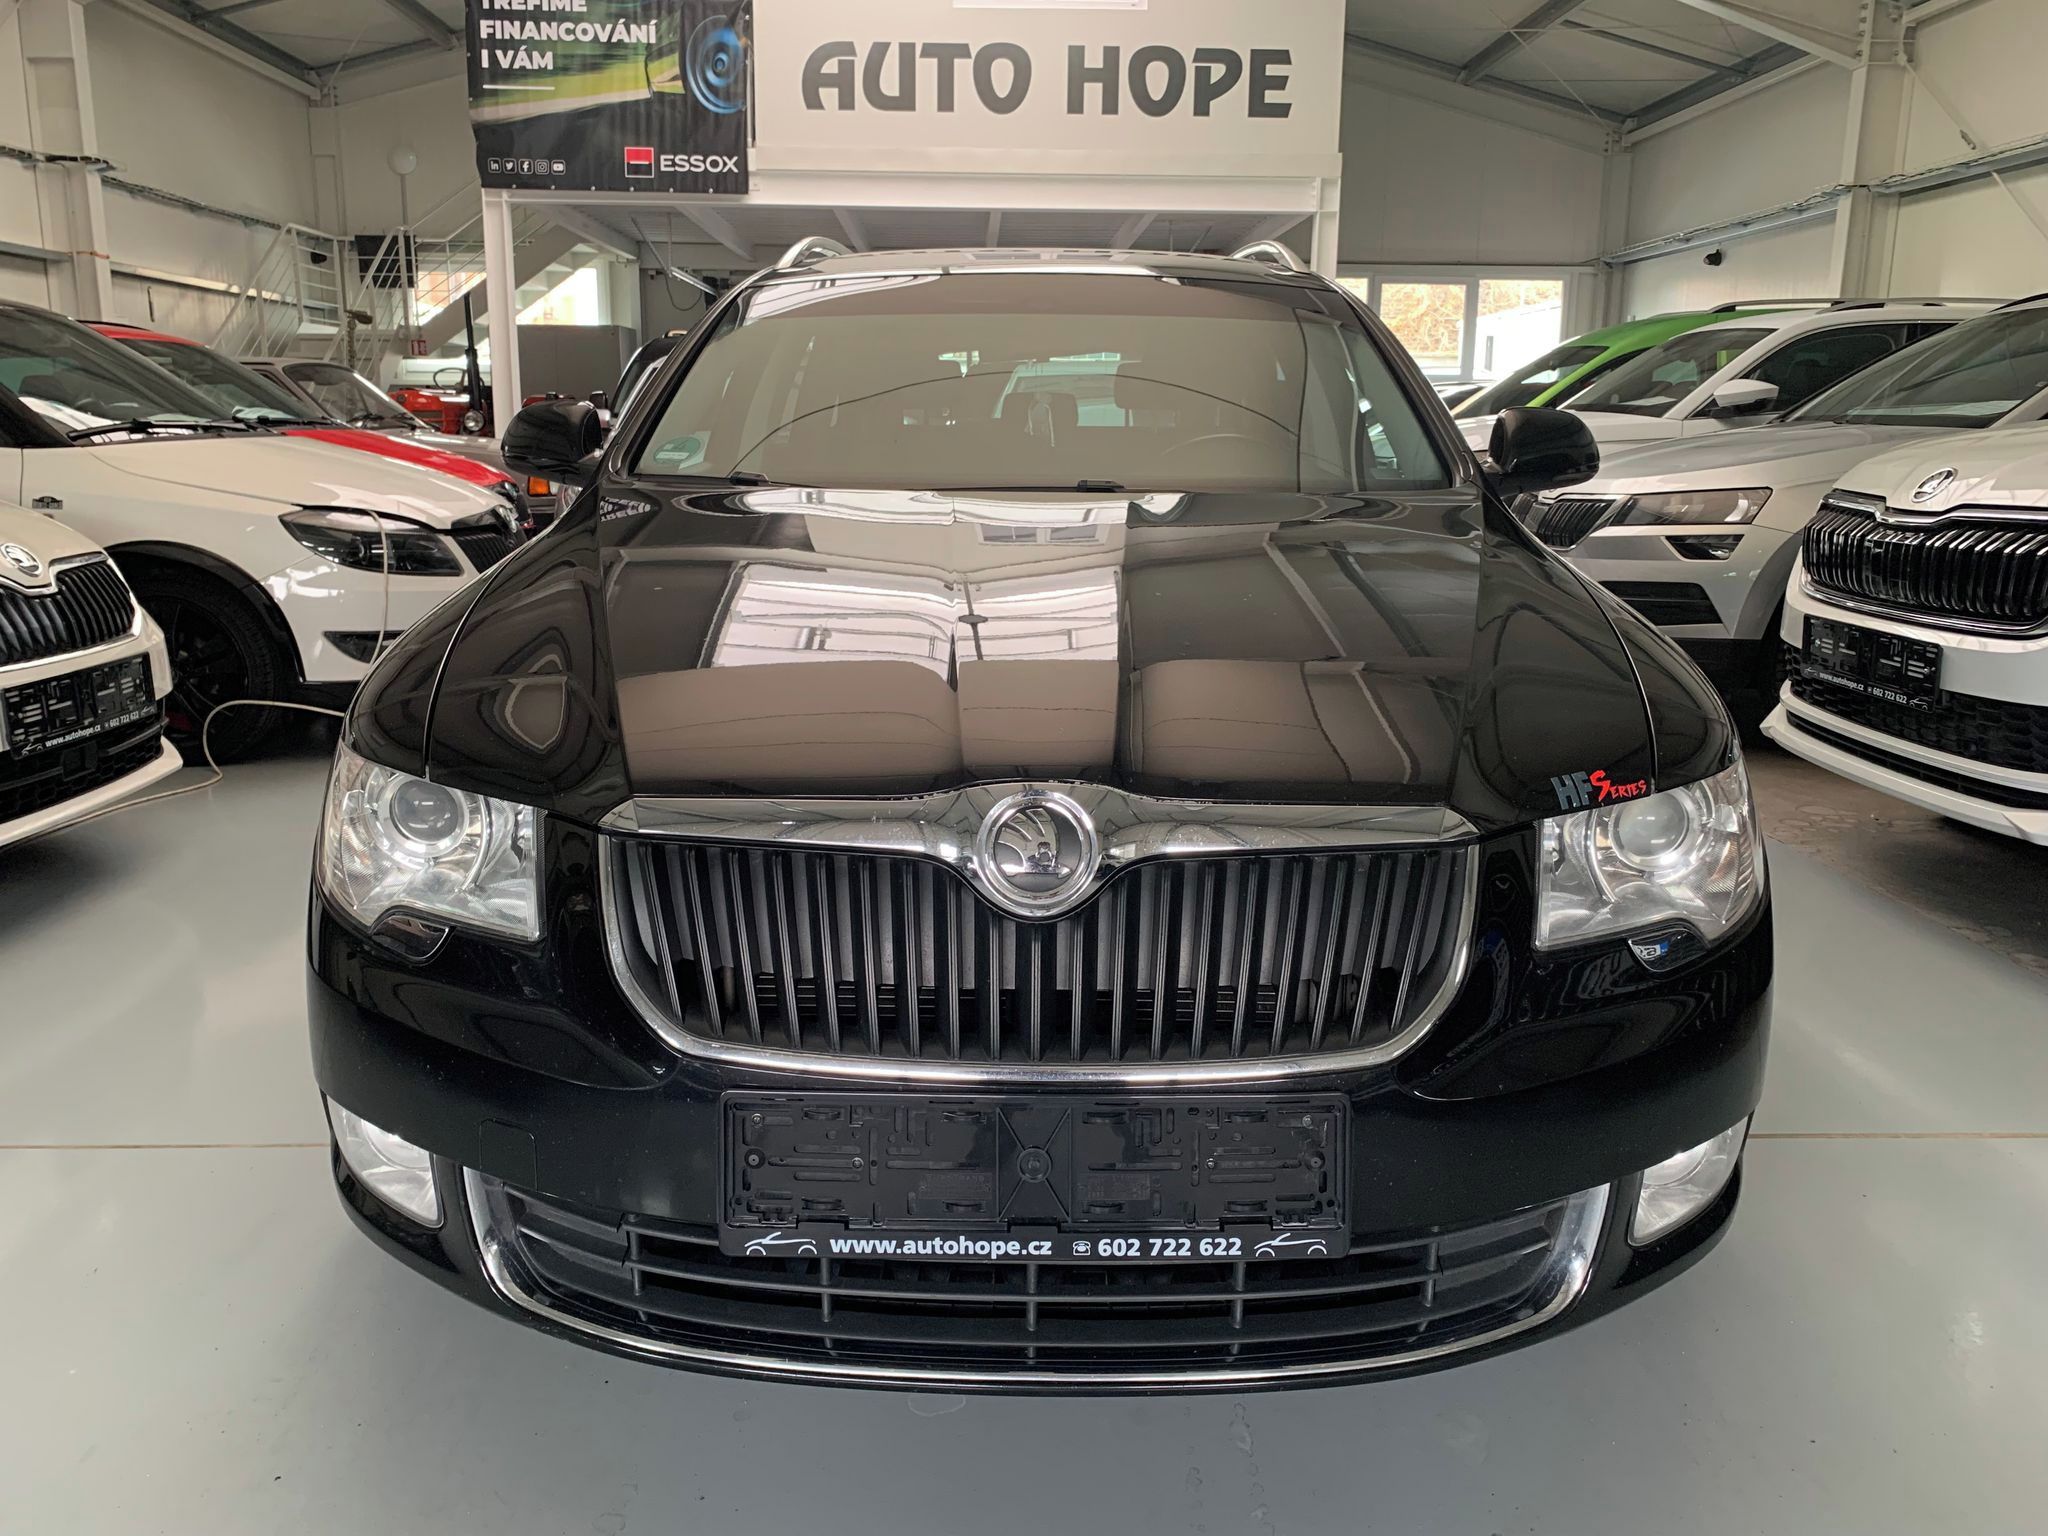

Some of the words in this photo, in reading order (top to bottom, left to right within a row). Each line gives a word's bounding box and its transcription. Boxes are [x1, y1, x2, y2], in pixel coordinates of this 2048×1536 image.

[480, 18, 658, 43] FINANCOVÁNÍ
[481, 48, 489, 69] I
[495, 45, 554, 70] VÁM
[801, 41, 1032, 115] AUTO
[1066, 45, 1293, 119] HOPE
[659, 154, 739, 173] ESSOX
[829, 1235, 1052, 1260] www.autohope.cz
[1098, 1237, 1141, 1257] 602
[1149, 1237, 1192, 1257] 722
[1199, 1237, 1242, 1257] 622
